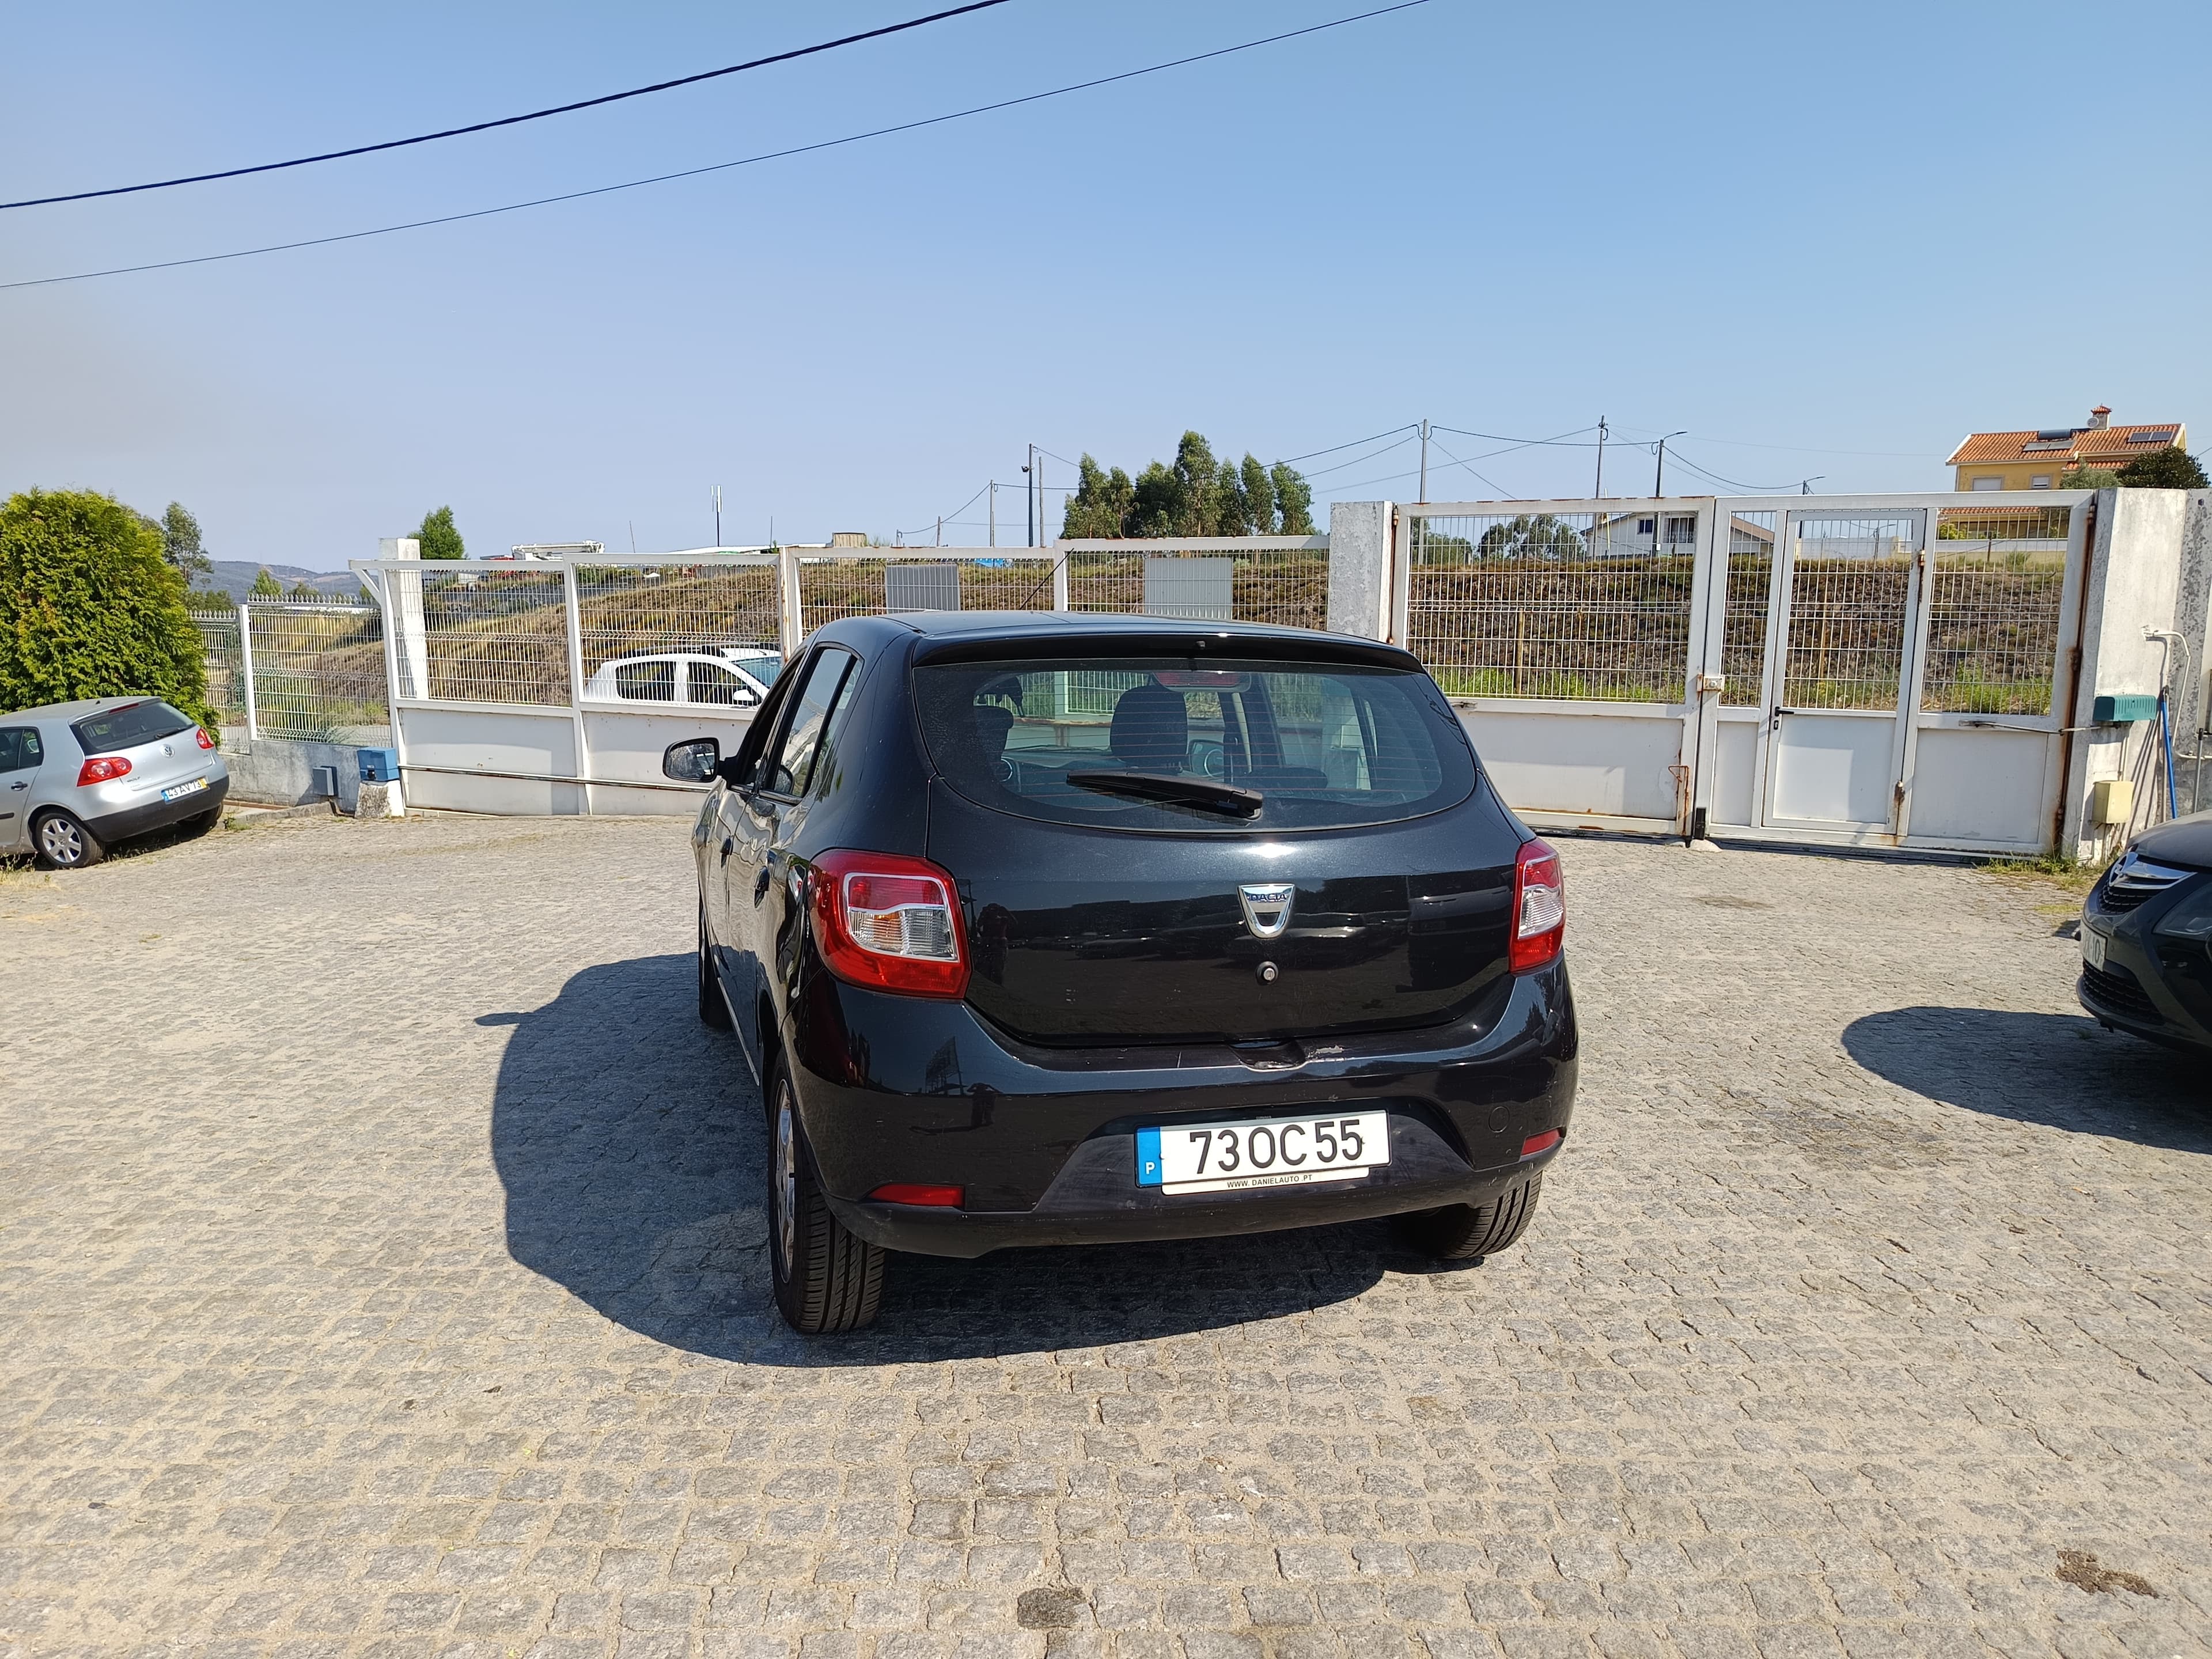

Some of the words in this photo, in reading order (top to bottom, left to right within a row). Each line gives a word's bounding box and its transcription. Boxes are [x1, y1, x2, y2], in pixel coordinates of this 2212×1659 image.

[1251, 893, 1287, 902] DACIA
[1145, 1162, 1155, 1175] P
[1252, 1176, 1300, 1186] DANIELAUTO
